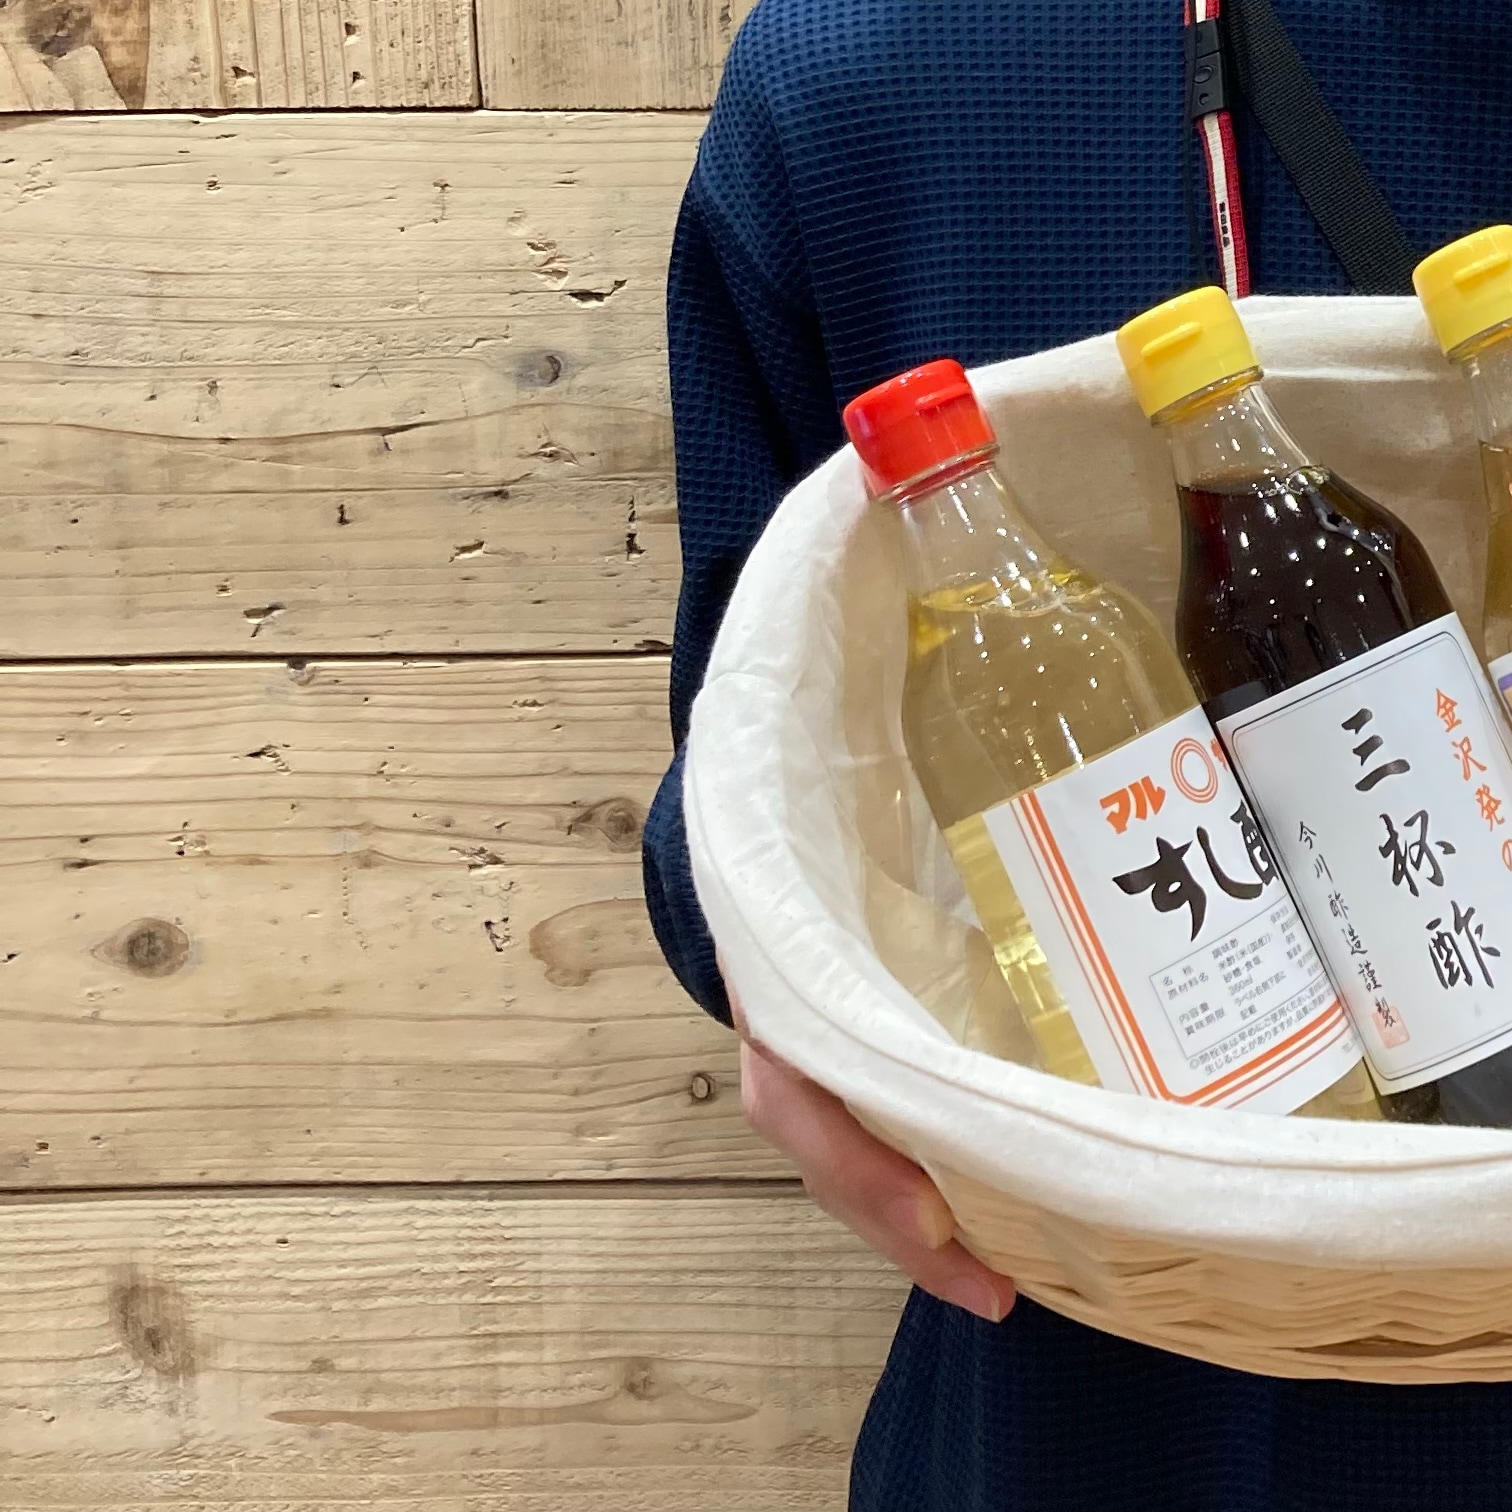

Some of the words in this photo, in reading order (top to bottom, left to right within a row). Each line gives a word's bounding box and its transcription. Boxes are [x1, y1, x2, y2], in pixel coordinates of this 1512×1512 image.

[1100, 775, 1166, 834] マル
[1341, 708, 1501, 989] 三杯酢
